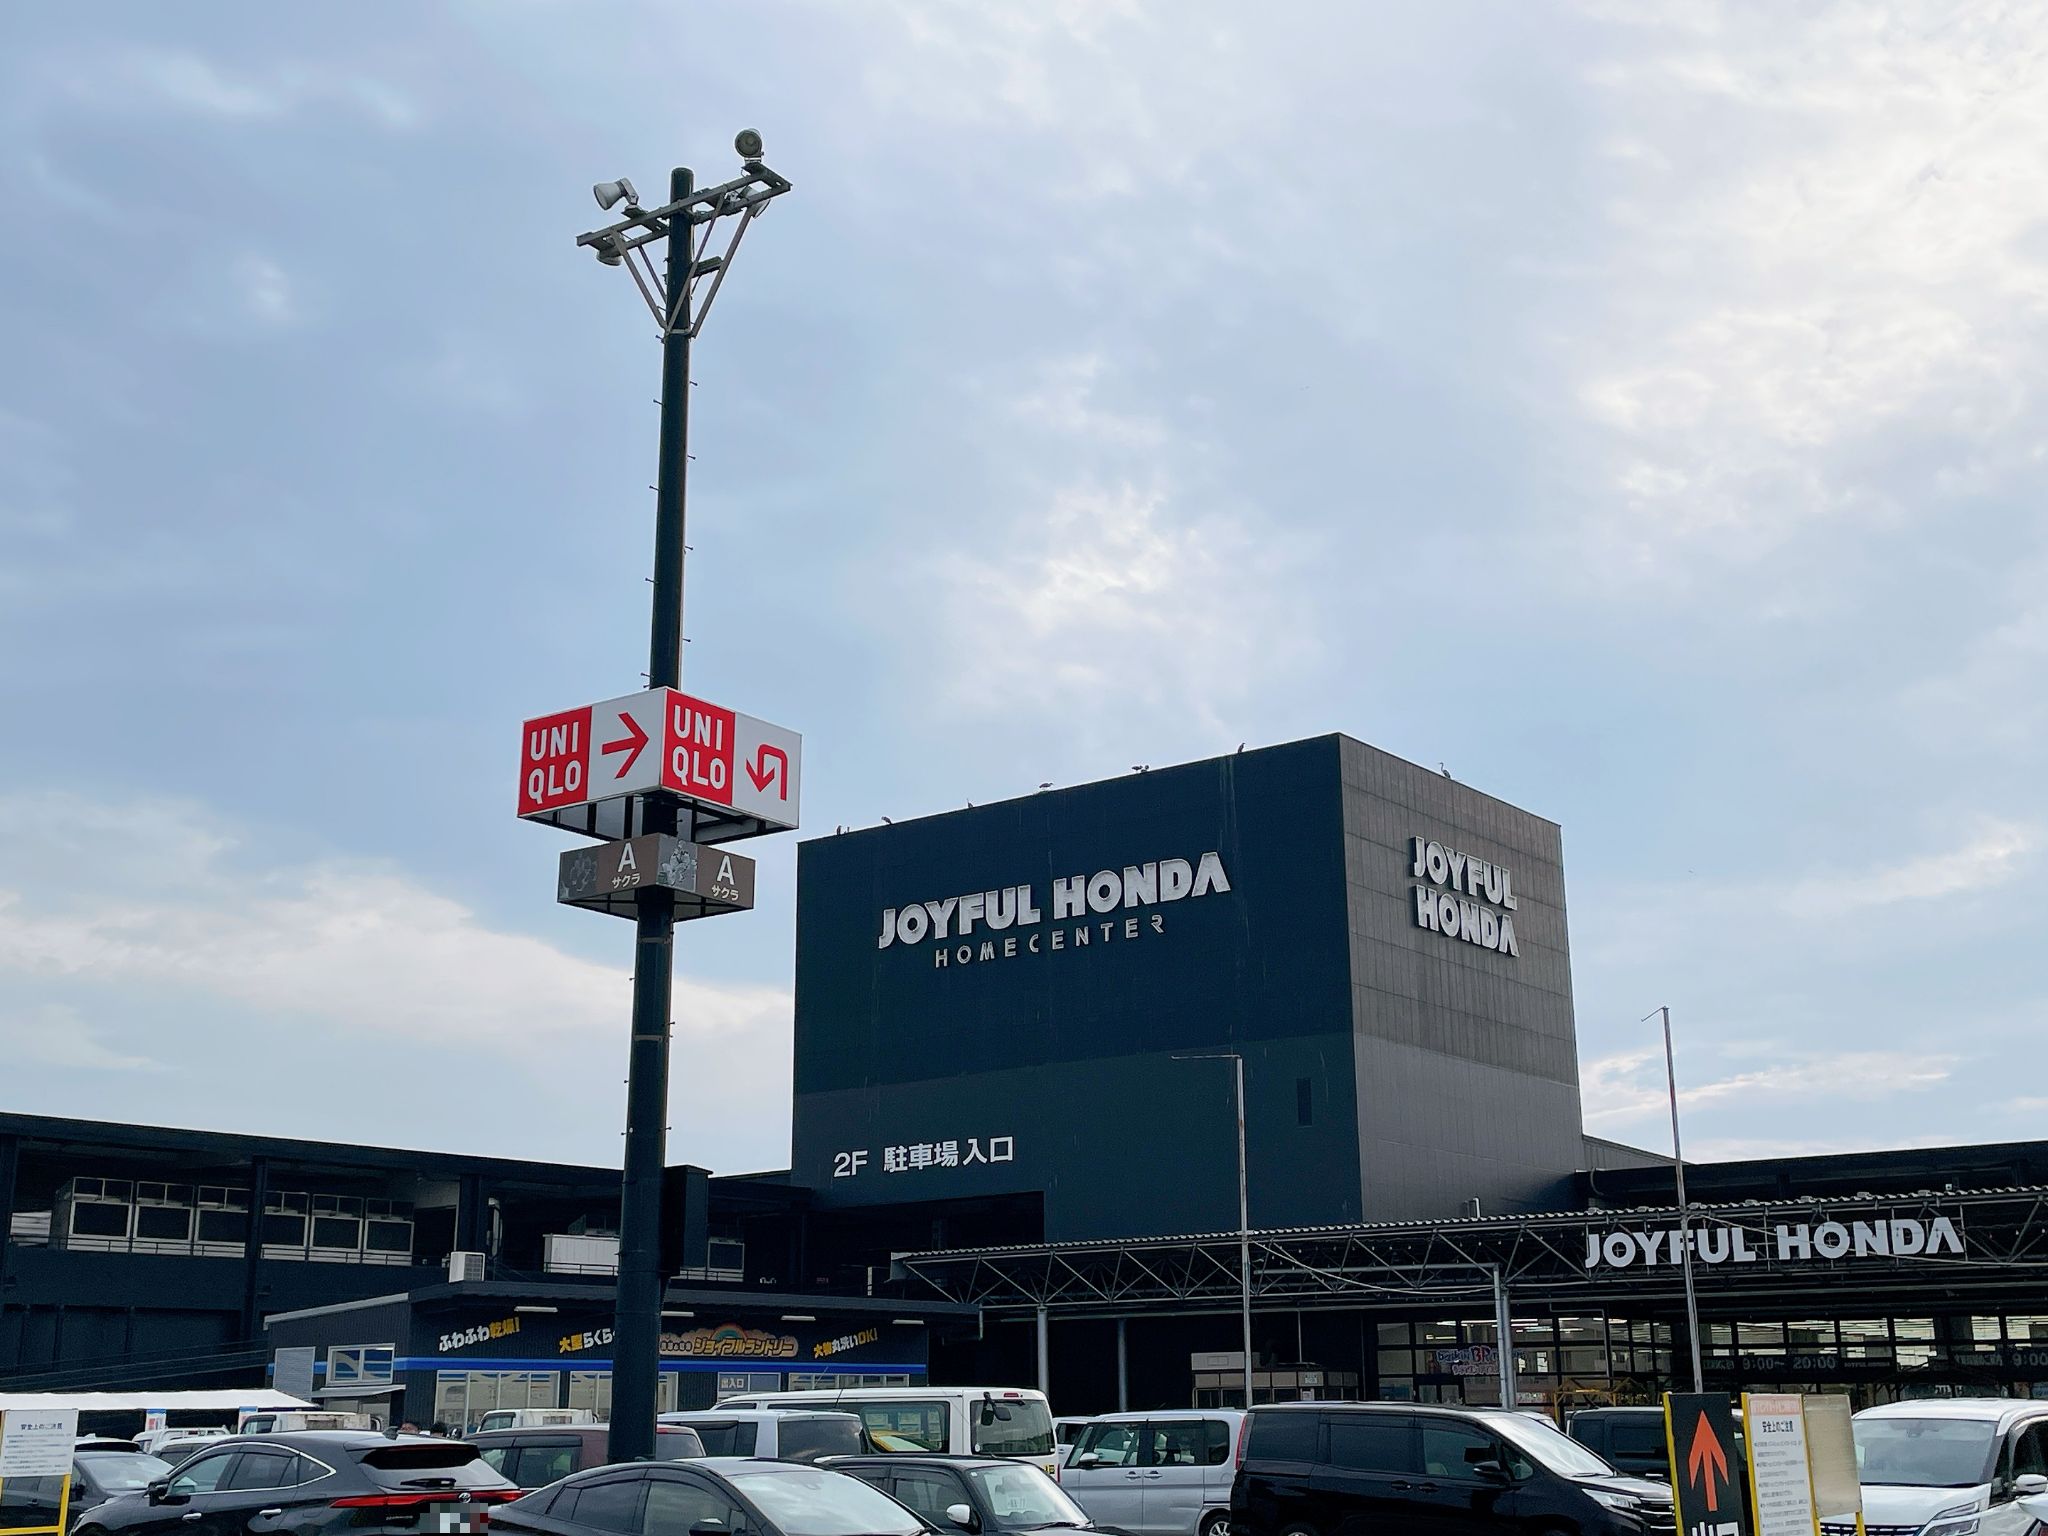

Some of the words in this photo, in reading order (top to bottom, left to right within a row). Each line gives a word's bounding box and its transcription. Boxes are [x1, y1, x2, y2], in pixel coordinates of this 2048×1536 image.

[530, 721, 580, 761] UNI
[673, 704, 723, 751] UNI
[528, 760, 582, 804] QLO
[672, 745, 726, 790] QLO
[617, 842, 637, 872] A
[716, 855, 735, 886] A
[1414, 835, 1518, 911] JOYFUL
[611, 872, 641, 889] サクラ
[711, 884, 740, 901] サクラ
[878, 884, 1041, 949] JOYFUL
[1053, 851, 1231, 919] HONDA
[1416, 884, 1520, 957] HONDA
[833, 1150, 868, 1178] 2F
[883, 1135, 1014, 1173] 駐車場入口
[1585, 1227, 1757, 1269] JOYFUL
[1776, 1216, 1964, 1260] HONDA
